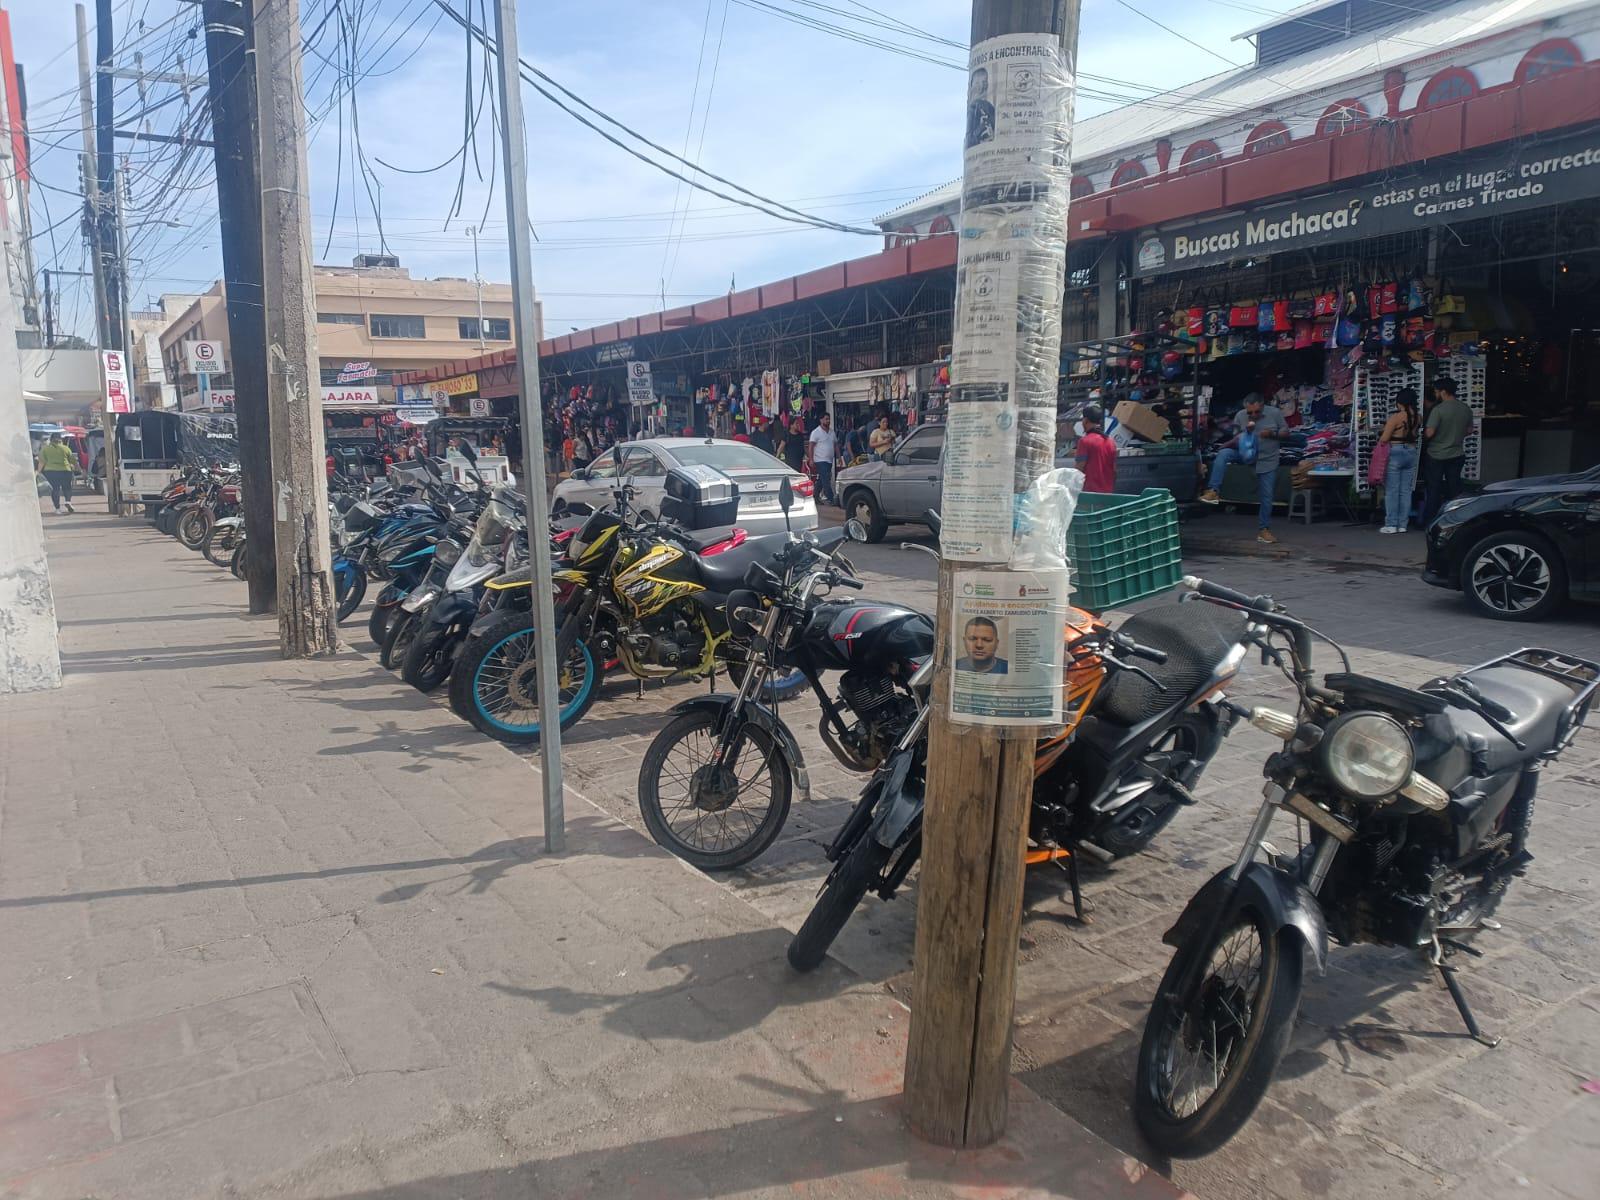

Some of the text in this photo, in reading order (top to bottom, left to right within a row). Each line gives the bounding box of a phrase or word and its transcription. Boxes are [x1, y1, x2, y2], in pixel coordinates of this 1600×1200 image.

[1372, 187, 1415, 208] estas
[1418, 183, 1441, 199] en
[1445, 175, 1462, 193] el
[1520, 148, 1600, 178] correcto
[1413, 181, 1544, 217] Carnes Tirado
[1174, 199, 1364, 260] Buscas Machaca?
[200, 346, 209, 357] E
[337, 368, 377, 384] Farmacia
[344, 362, 370, 372] Super
